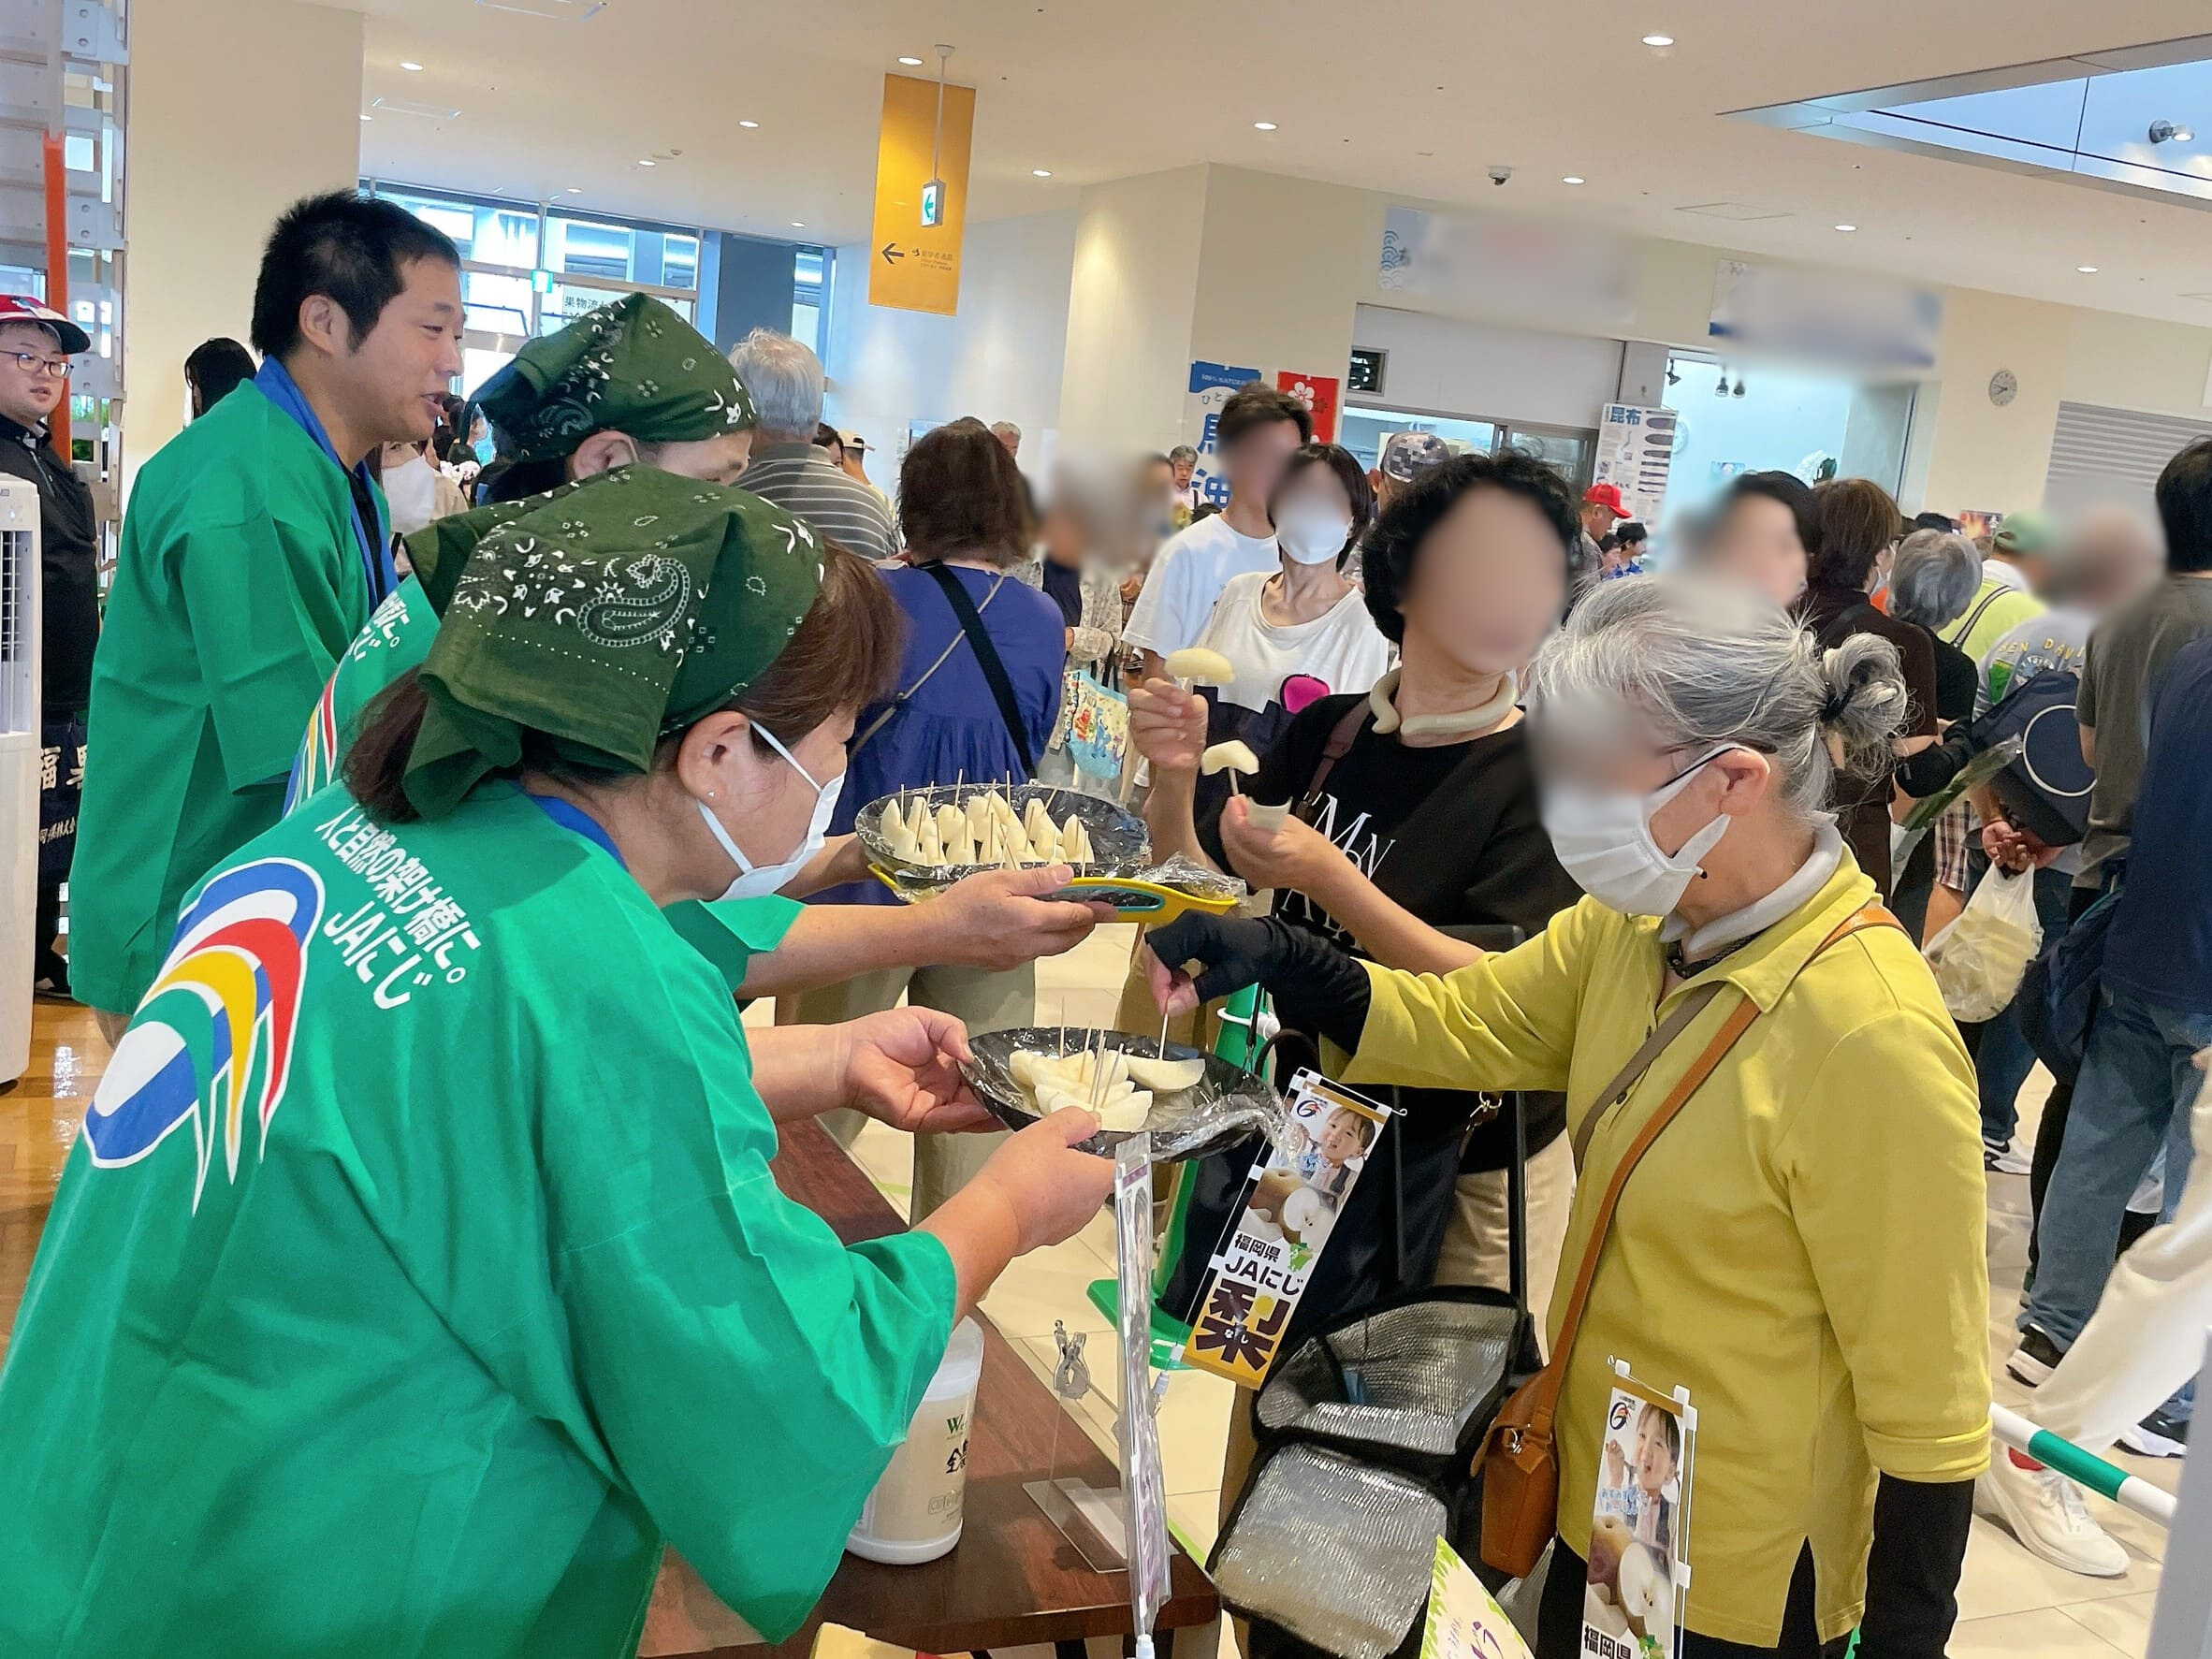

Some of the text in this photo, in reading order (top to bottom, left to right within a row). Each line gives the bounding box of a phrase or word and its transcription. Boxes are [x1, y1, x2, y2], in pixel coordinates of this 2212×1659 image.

[1609, 405, 1641, 425] 昆布
[2044, 637, 2085, 660] DAVI
[314, 803, 481, 983] 人と自然の架け橋に。
[324, 900, 433, 1010] JAにじ
[1234, 1233, 1281, 1263] 福岡県
[1225, 1256, 1304, 1296] JAにじ
[1195, 1277, 1291, 1372] 梨
